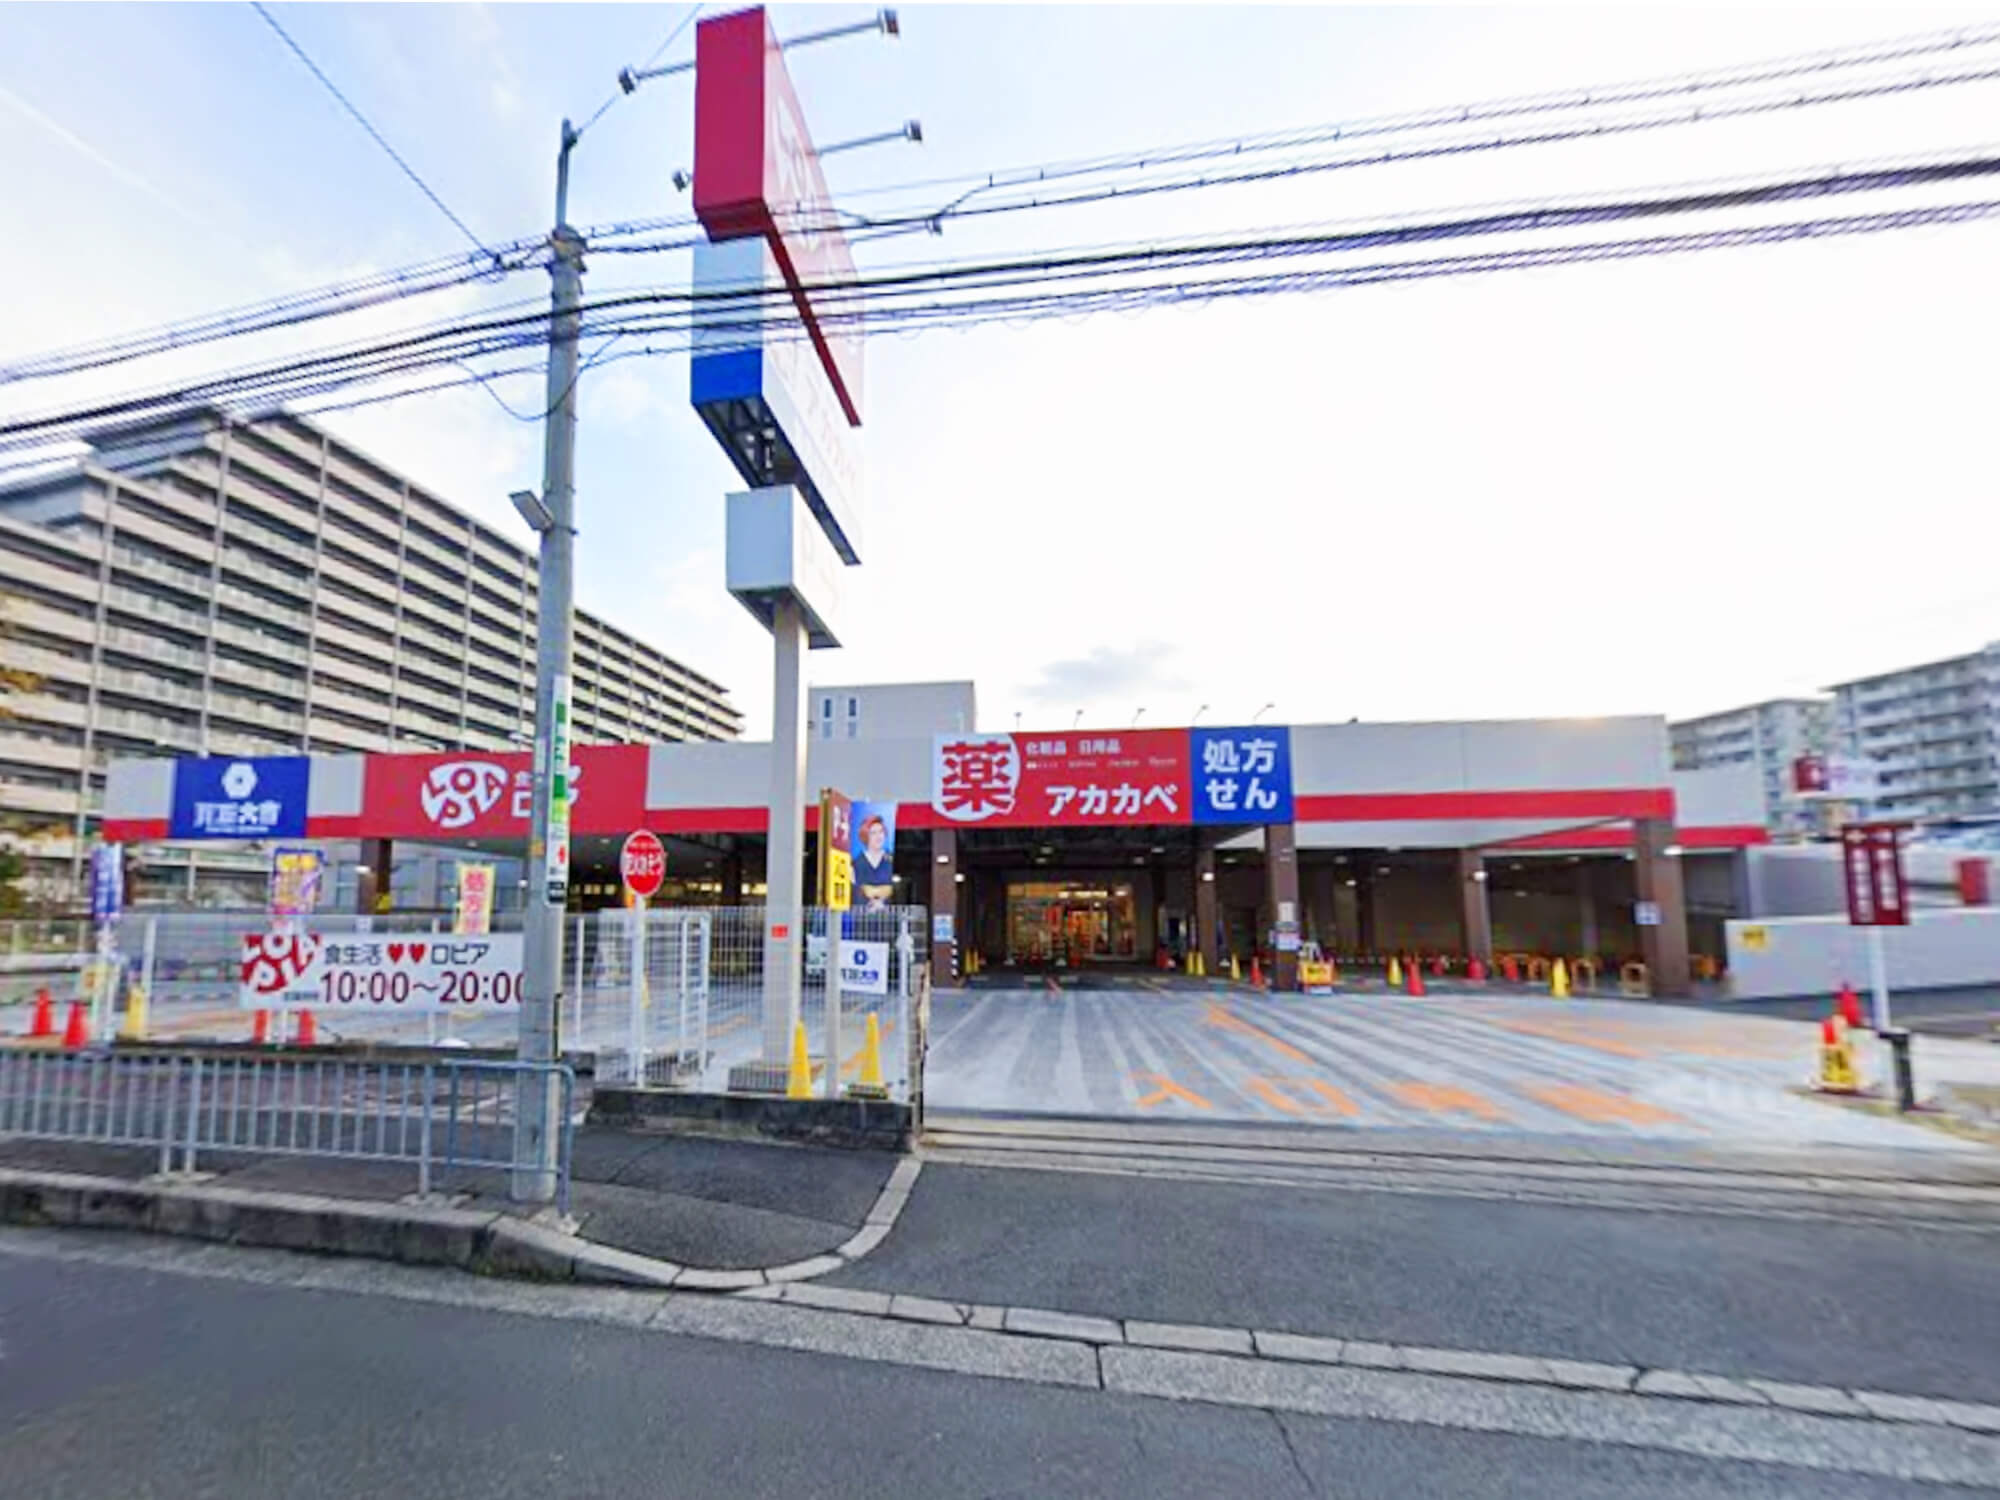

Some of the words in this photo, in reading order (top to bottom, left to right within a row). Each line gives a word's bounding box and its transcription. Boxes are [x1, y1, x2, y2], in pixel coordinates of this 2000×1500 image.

[1203, 738, 1277, 774] 処方
[942, 741, 1011, 812] 薬
[1045, 782, 1178, 816] アカカベ
[1205, 777, 1278, 811] せん
[325, 943, 382, 966] 食生活
[431, 943, 490, 966] ロピア
